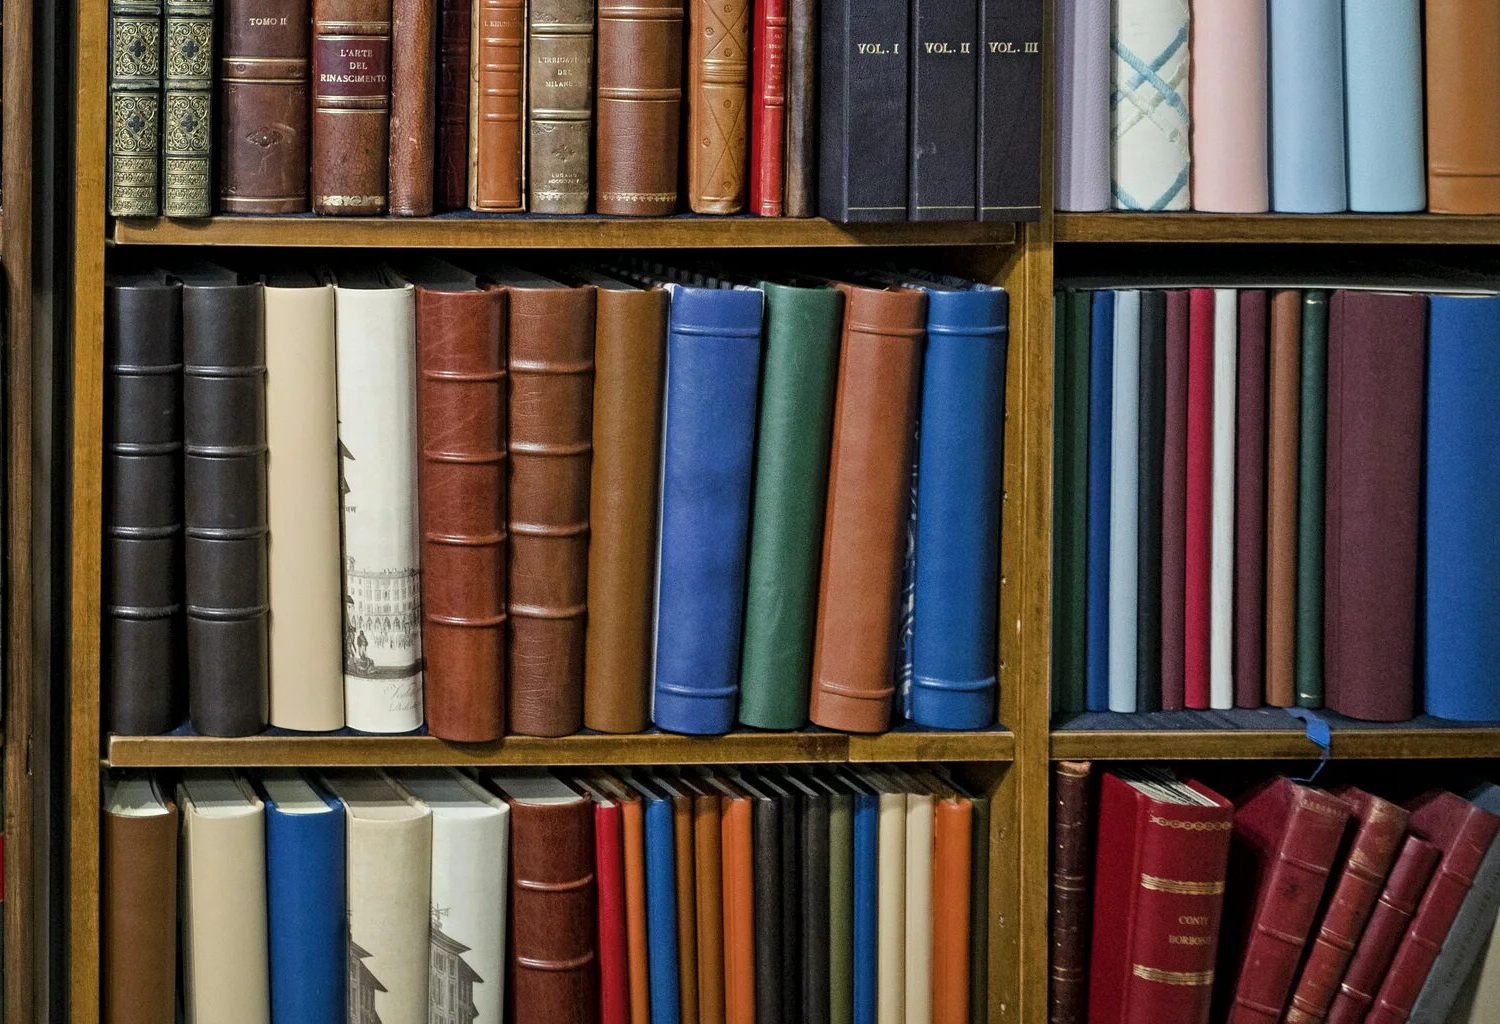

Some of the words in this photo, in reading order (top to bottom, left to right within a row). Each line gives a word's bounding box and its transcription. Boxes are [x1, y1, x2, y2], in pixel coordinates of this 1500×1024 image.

[250, 16, 276, 27] TOMO
[278, 16, 287, 27] II
[340, 48, 374, 59] L'ARTE
[857, 43, 888, 55] VOL.
[894, 43, 900, 55] I
[924, 43, 957, 55] VOL.
[960, 43, 970, 55] II
[988, 42, 1020, 54] VOL.
[1024, 42, 1039, 54] III
[350, 60, 368, 70] DEL
[320, 74, 387, 84] RINASCIMENTO
